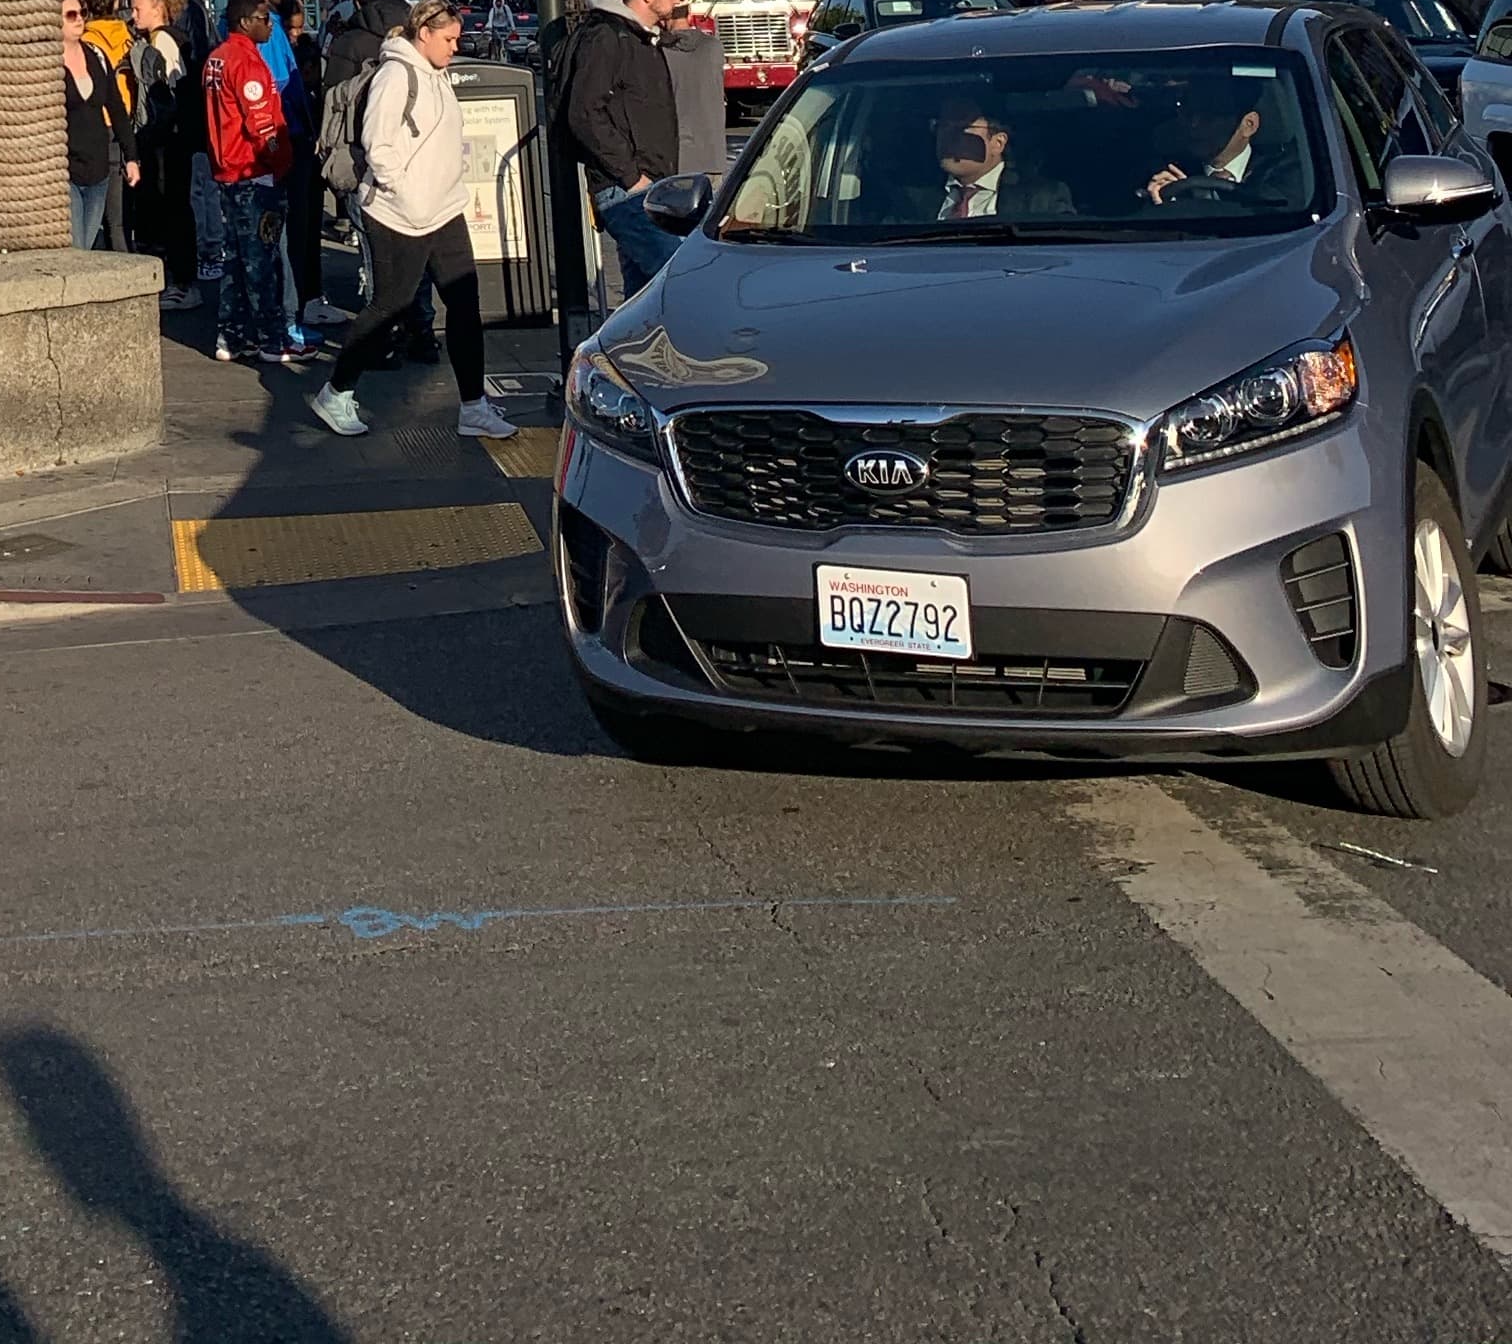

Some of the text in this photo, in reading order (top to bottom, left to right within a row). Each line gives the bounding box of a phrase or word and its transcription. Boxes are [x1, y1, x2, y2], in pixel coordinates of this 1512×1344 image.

[856, 459, 913, 485] KIA
[828, 579, 909, 598] WASHINGTON
[829, 594, 960, 643] BQZ2792
[860, 637, 932, 651] EVERGREEN STATE
